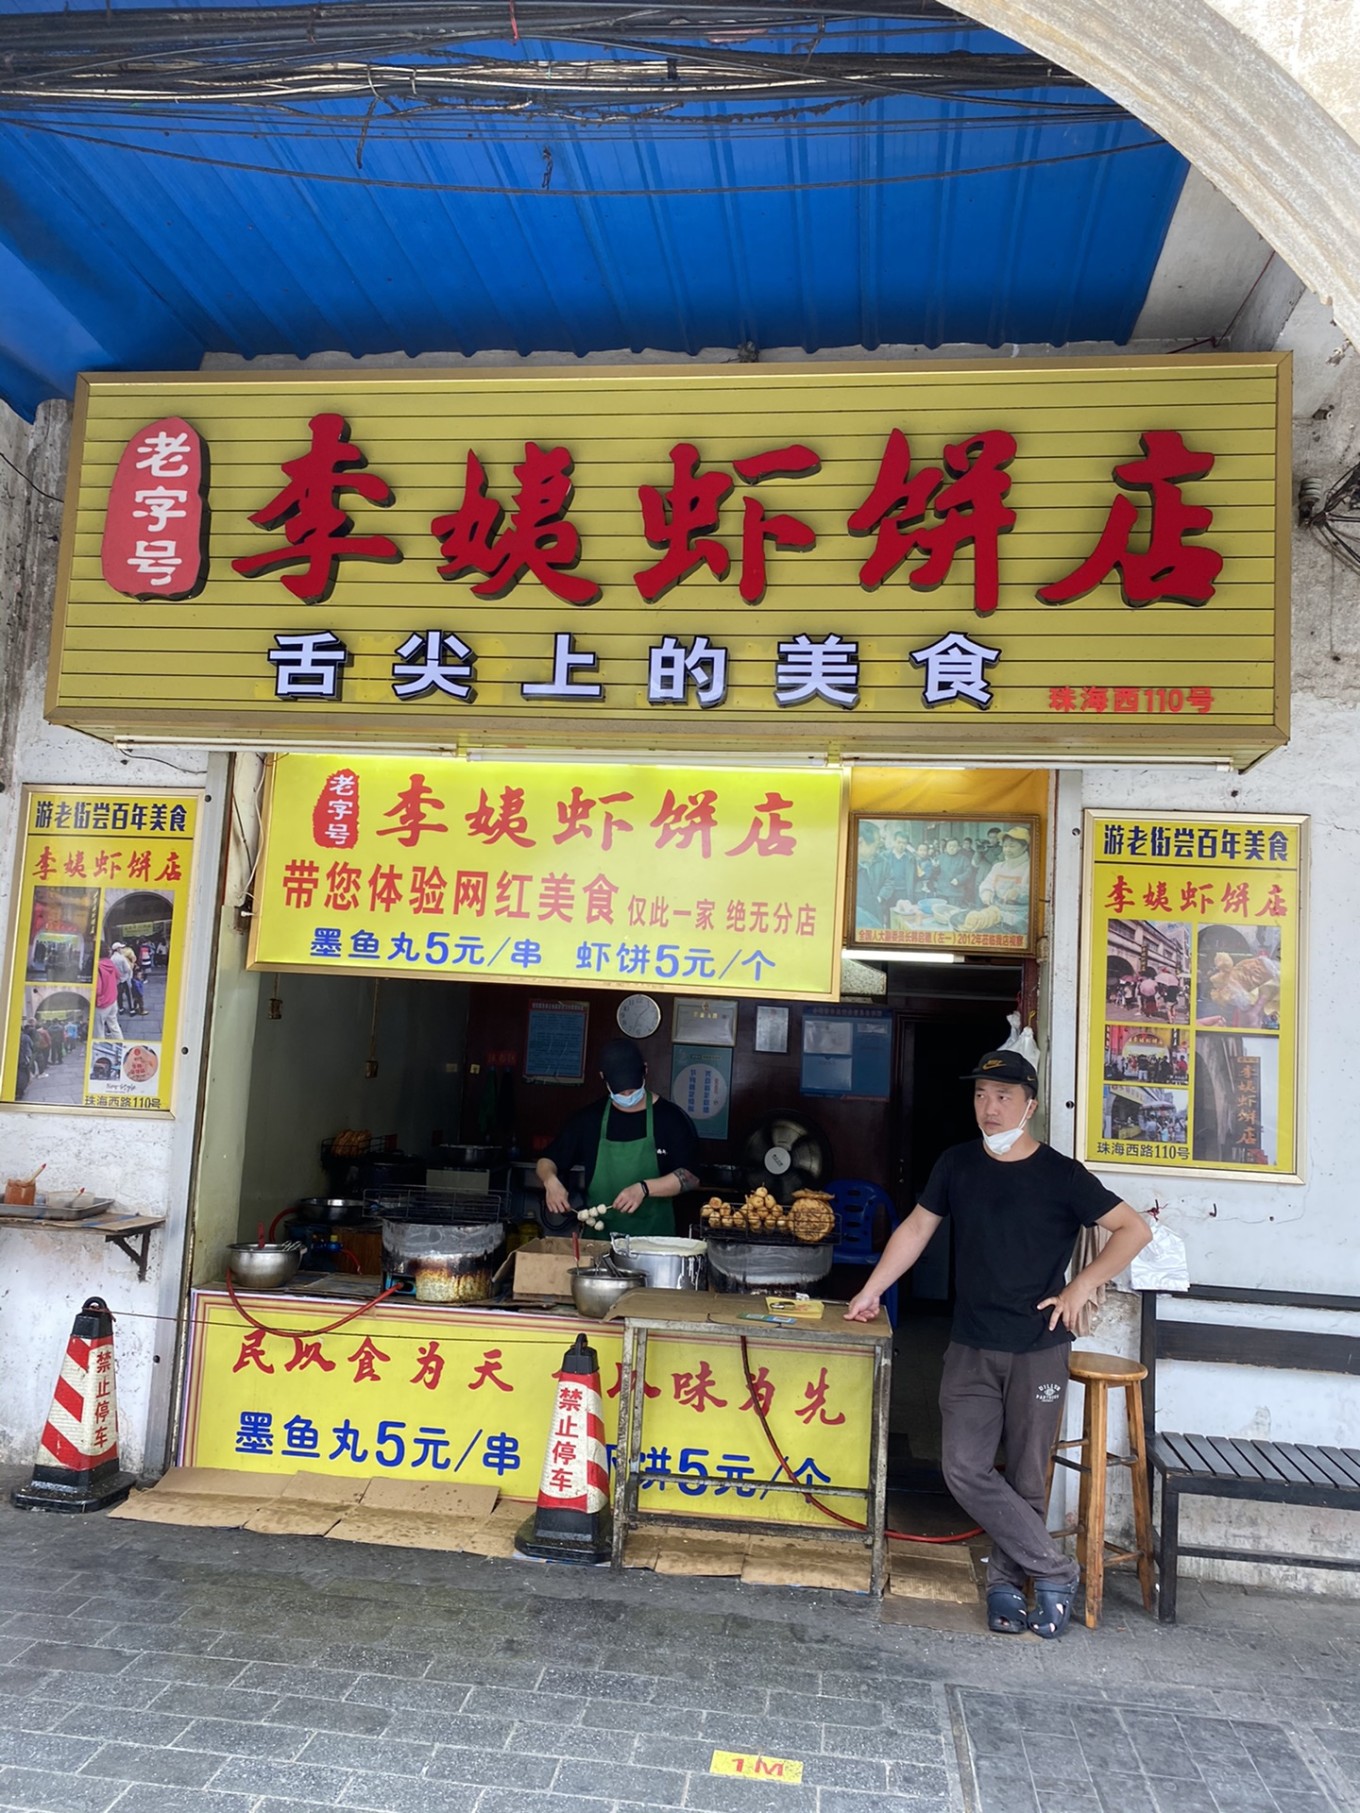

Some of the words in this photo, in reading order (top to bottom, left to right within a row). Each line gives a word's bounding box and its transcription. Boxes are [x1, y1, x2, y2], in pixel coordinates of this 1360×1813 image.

[127, 431, 191, 587] 老字号
[231, 413, 1224, 617] 李姨虾饼店
[267, 630, 1002, 710] 舌尖上的美食
[1048, 686, 1215, 714] 珠海西110号
[35, 801, 187, 832] 游老街尝百年美食
[323, 774, 354, 846] 老字号
[376, 773, 797, 859] 李姨虾饼店
[1103, 824, 1290, 862] 游老街尝百年美食
[32, 846, 183, 882] 李姨虾饼店
[282, 859, 620, 925] 带您体验网红美食
[628, 893, 717, 932] 仅此一家
[726, 899, 818, 938] 绝无分店
[1104, 875, 1289, 918] 李姨虾饼店
[310, 927, 543, 970] 墨鱼丸5元/串
[576, 940, 776, 982] 虾饼5元/个
[84, 1095, 162, 1109] 珠海西路110号
[1096, 1141, 1190, 1161] 珠海西路110号
[93, 1351, 112, 1449] 禁止停车
[232, 1328, 515, 1393] 民以食为天
[552, 1360, 846, 1426] 以味为先
[235, 1410, 521, 1477] 墨鱼丸5元/串
[606, 1444, 832, 1504] 饼5元/个
[550, 1386, 583, 1493] 禁止停车
